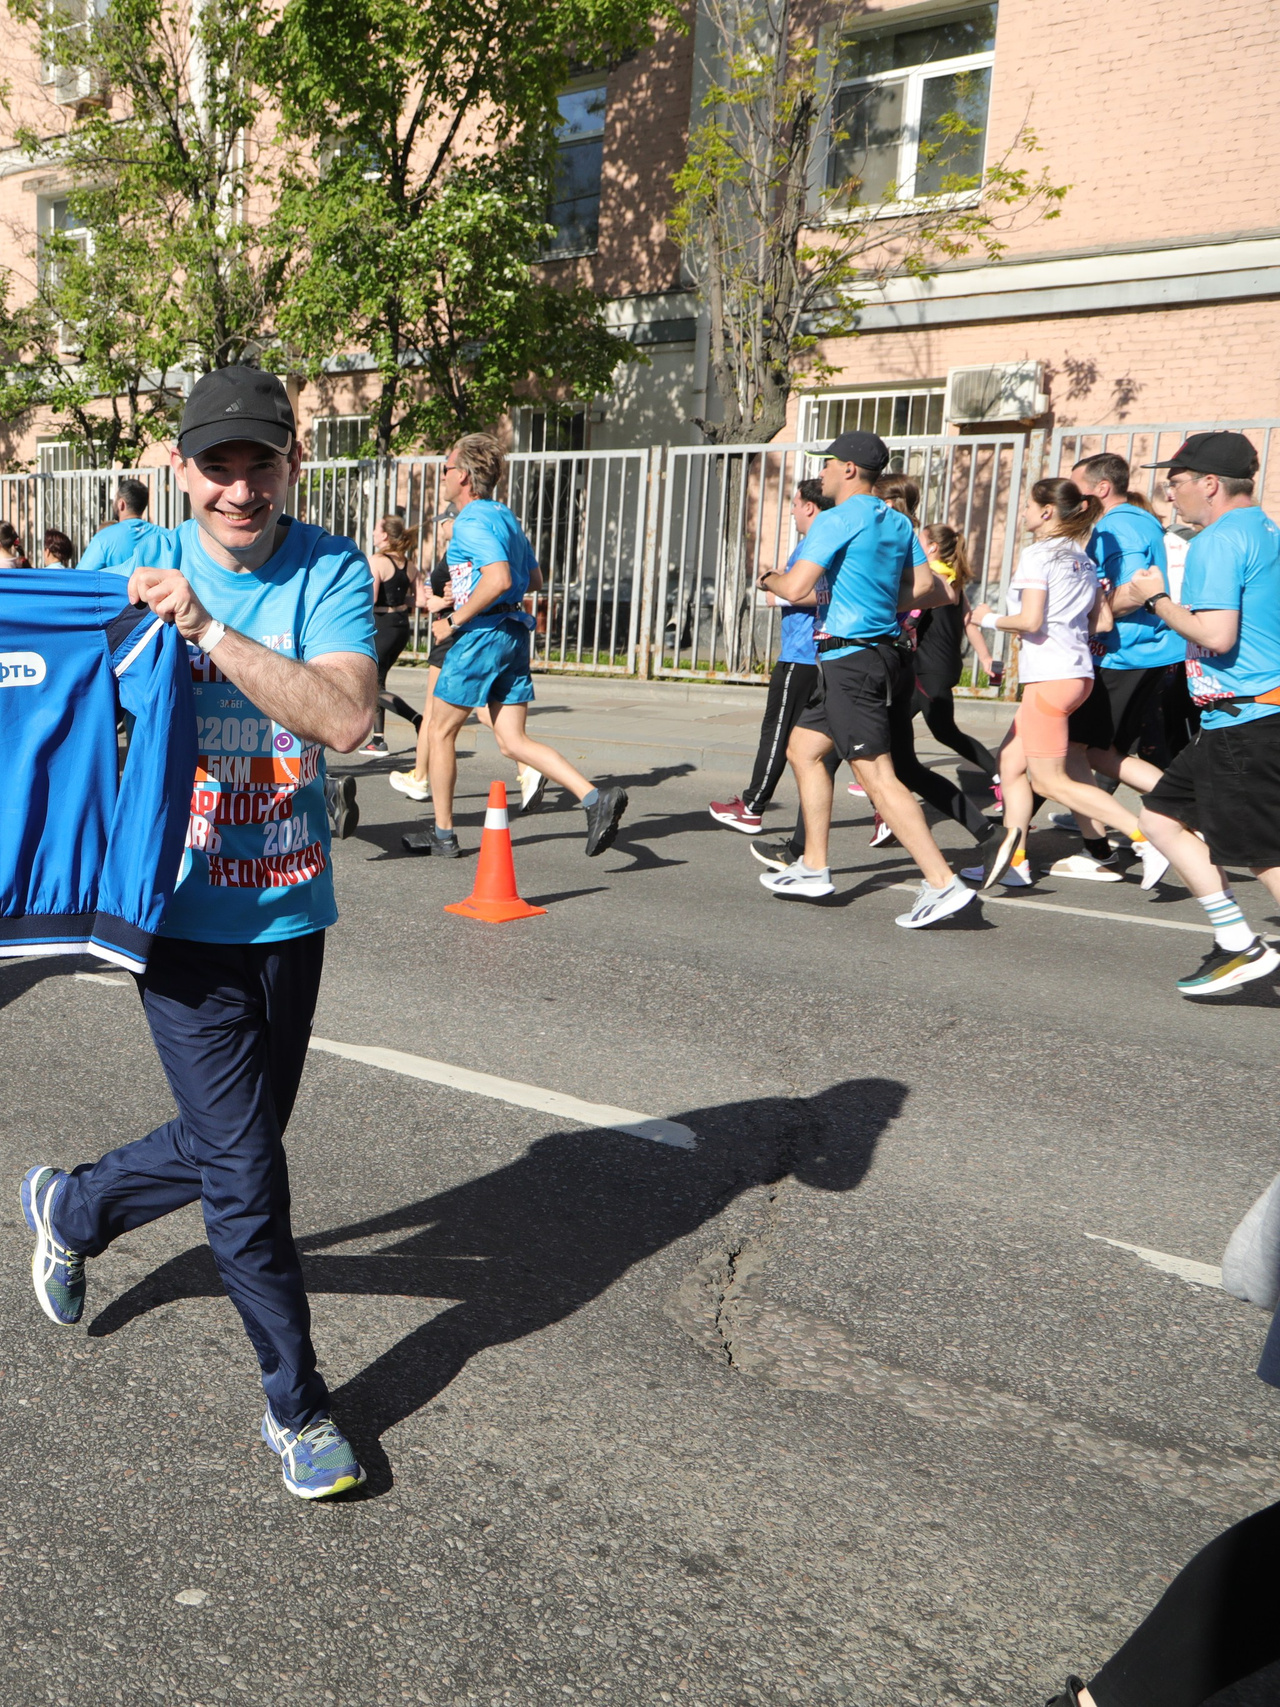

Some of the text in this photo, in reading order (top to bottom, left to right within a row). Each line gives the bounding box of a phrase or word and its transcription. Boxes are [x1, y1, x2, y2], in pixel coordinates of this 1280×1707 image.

[207, 755, 251, 783] 5KM
[263, 811, 309, 856] 2024
[208, 840, 327, 888] #ЕДИНСТВО
